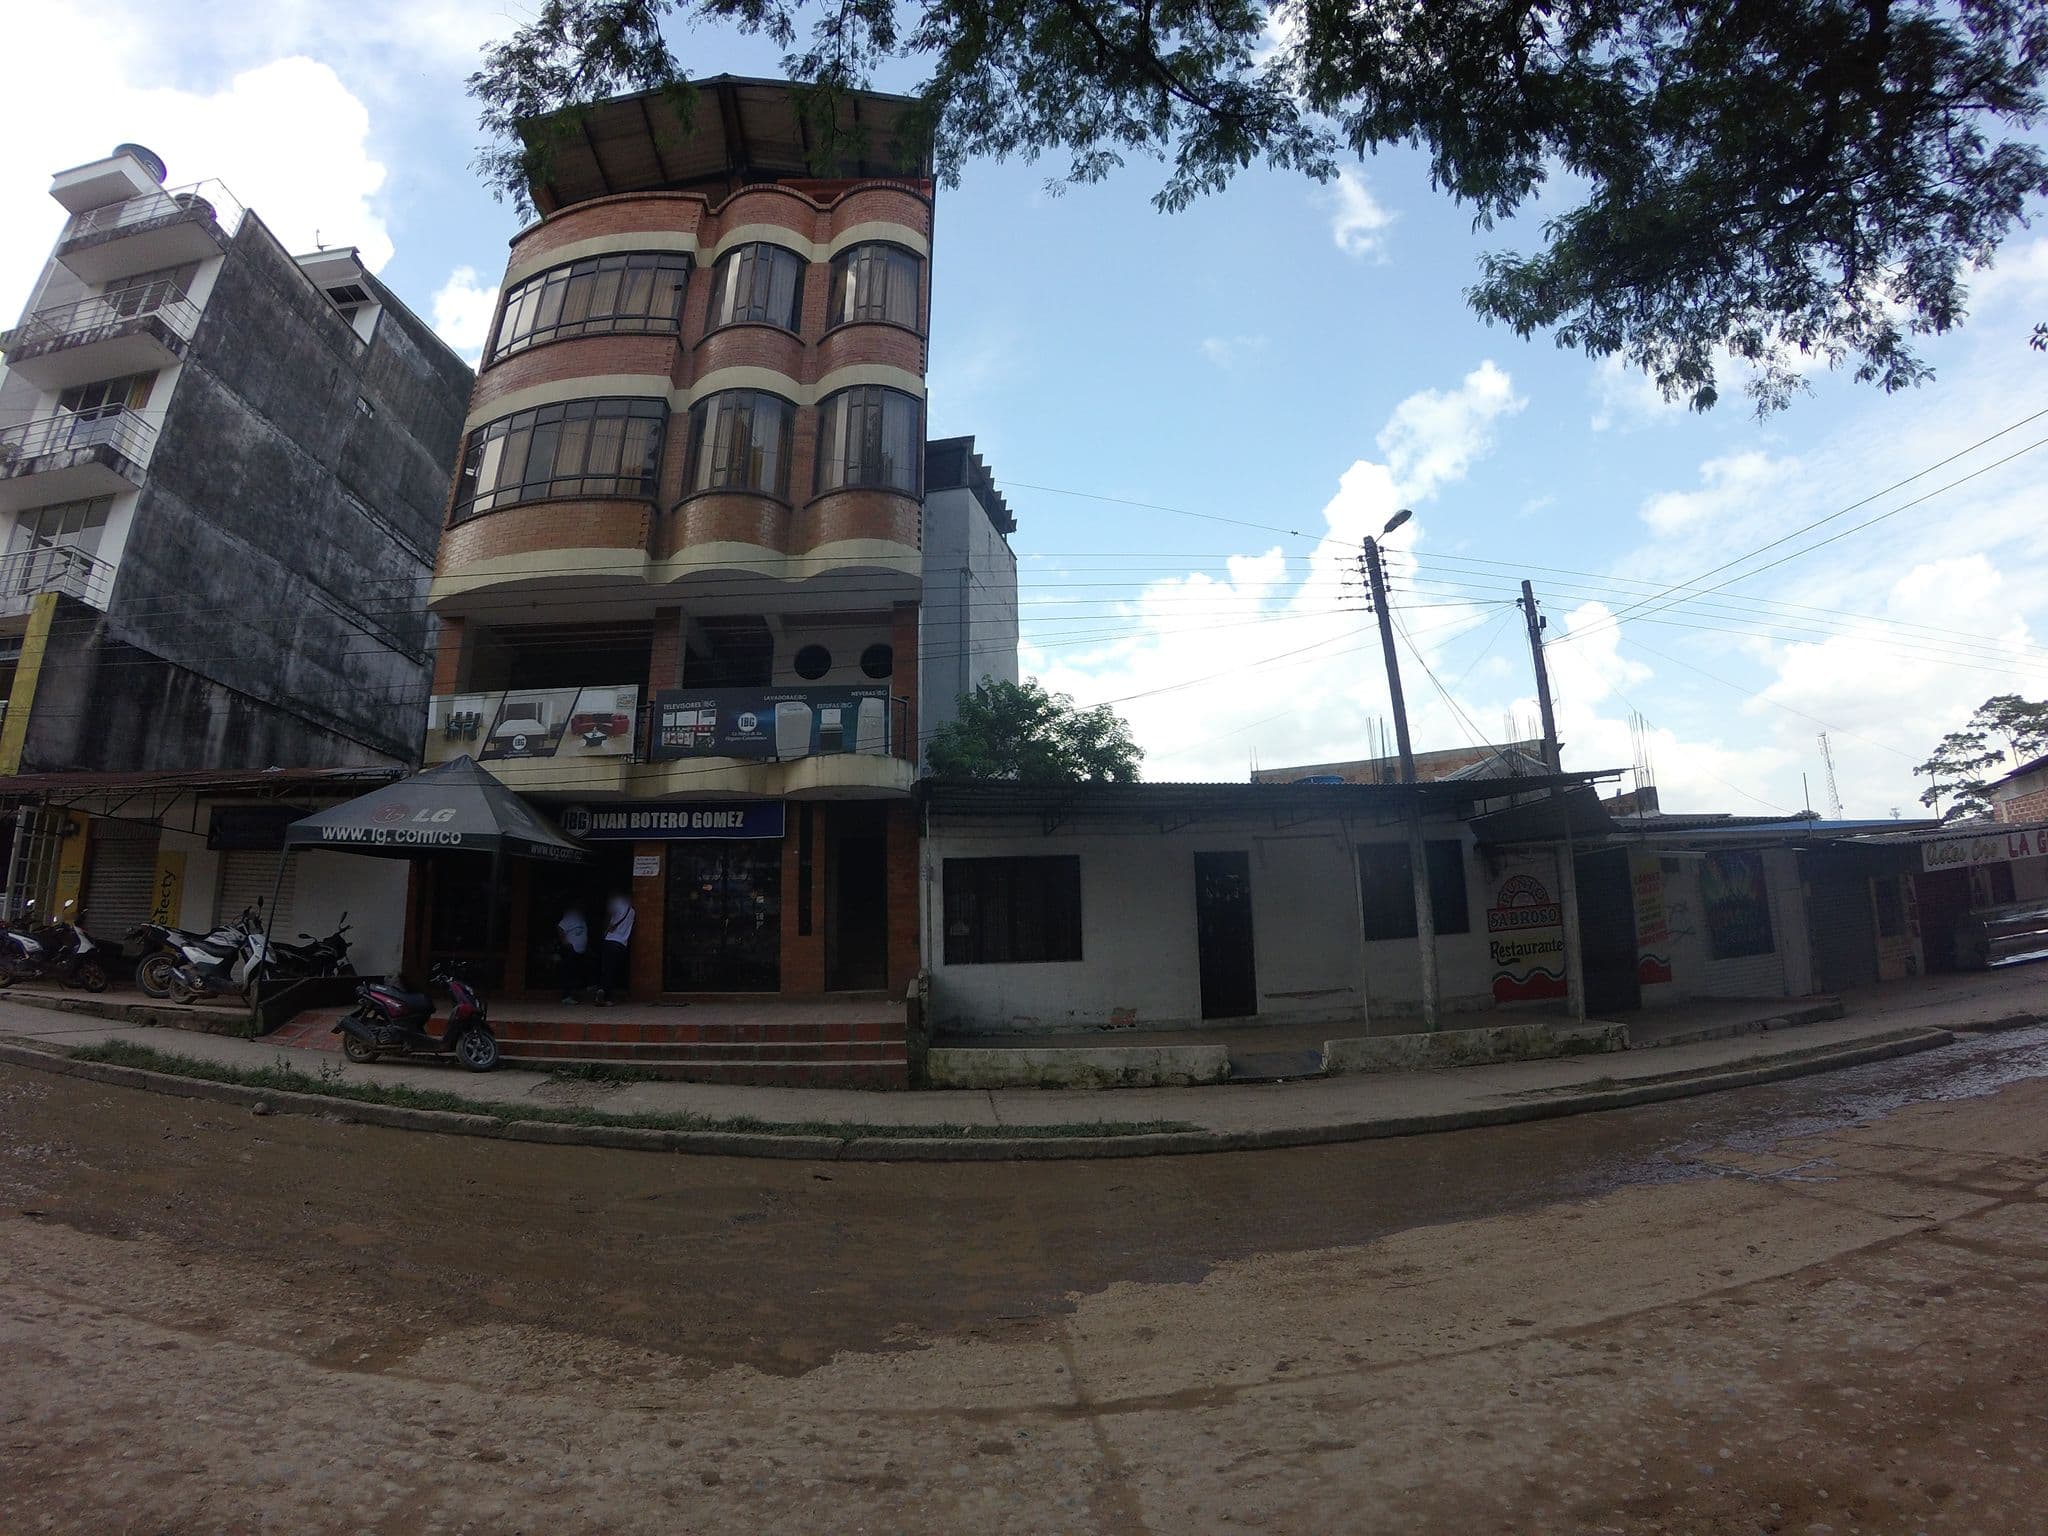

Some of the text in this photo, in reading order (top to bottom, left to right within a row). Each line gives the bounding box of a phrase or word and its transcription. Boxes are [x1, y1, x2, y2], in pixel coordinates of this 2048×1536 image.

[740, 716, 756, 728] IBG
[412, 808, 457, 823] LG
[593, 813, 627, 830] IVAN
[630, 812, 688, 830] BOTERO
[692, 810, 745, 829] GOMEZ
[152, 869, 176, 925] efecty
[1490, 908, 1559, 928] SABROSO
[1489, 937, 1565, 964] Restaurante
